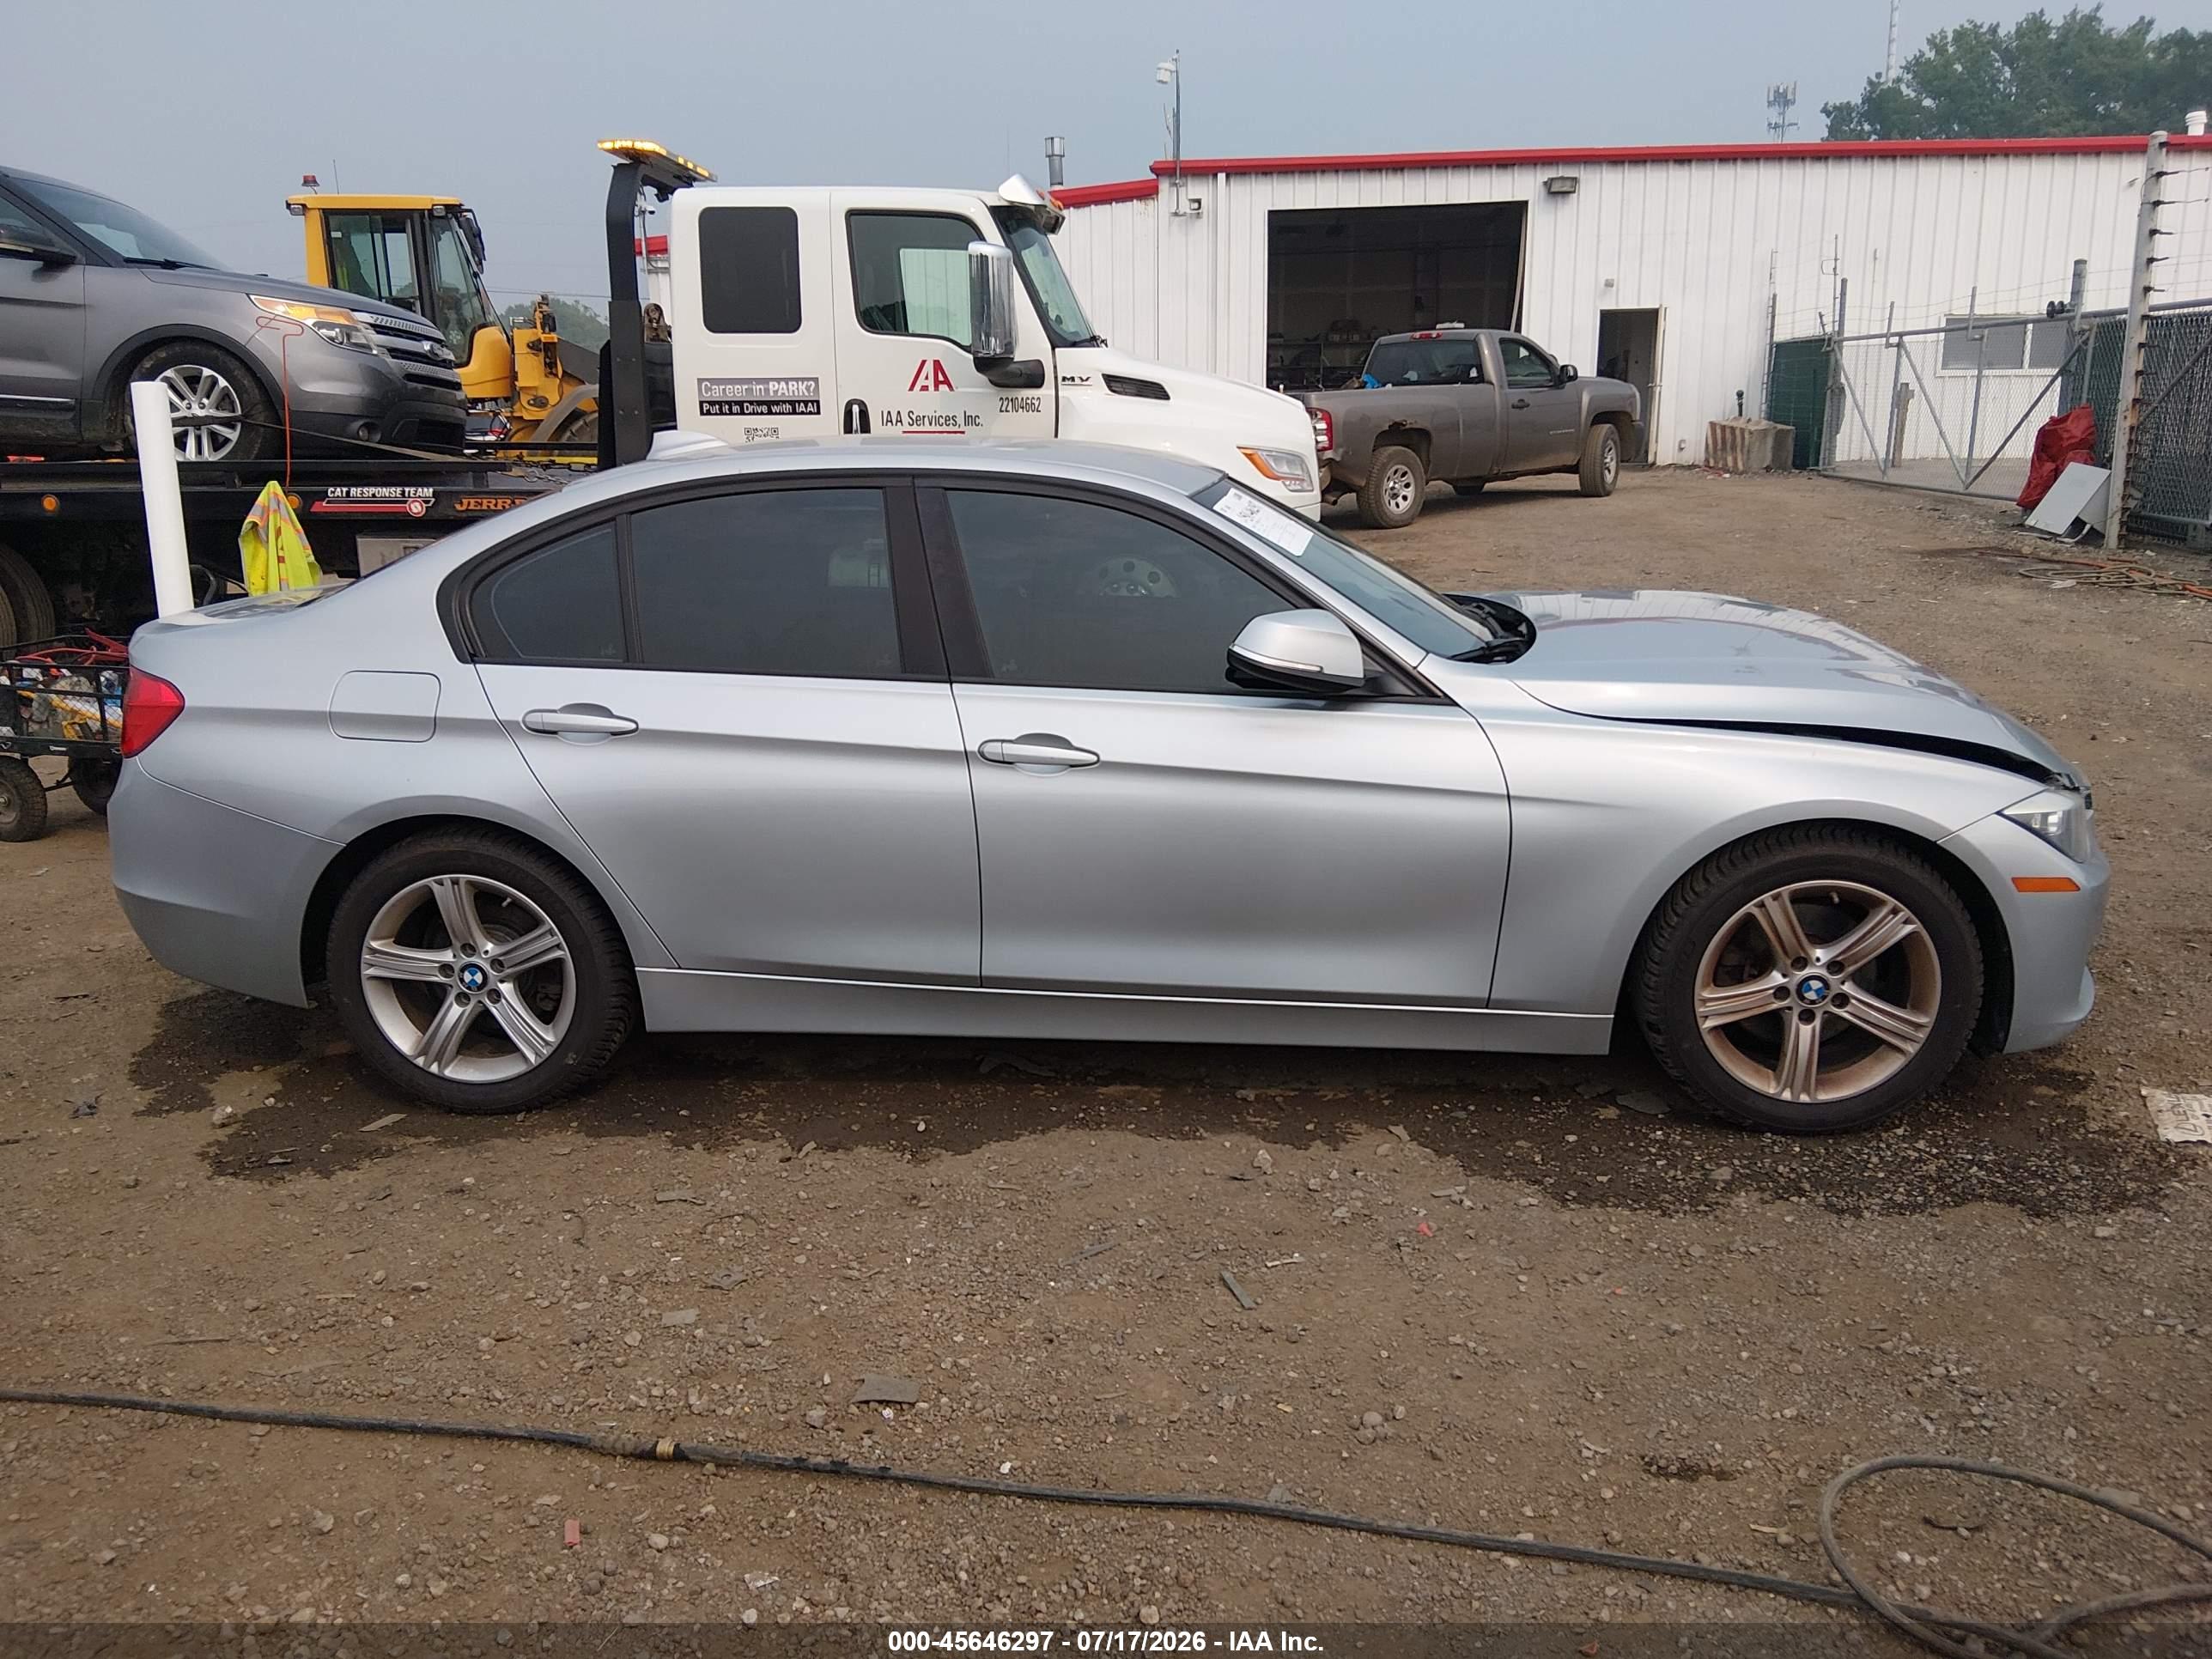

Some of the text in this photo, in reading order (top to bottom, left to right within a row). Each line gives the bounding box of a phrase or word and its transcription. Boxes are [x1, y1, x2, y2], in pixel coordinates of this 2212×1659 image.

[702, 380, 816, 398] Career in PARK?
[702, 403, 720, 414] Put
[722, 403, 729, 414] it
[732, 403, 741, 414] in
[744, 403, 769, 414] Drive
[771, 402, 793, 414] with
[999, 397, 1042, 413] 22104662
[881, 410, 983, 428] IAA Services, Inc.
[327, 487, 434, 498] CAT RESPONSE TEAM
